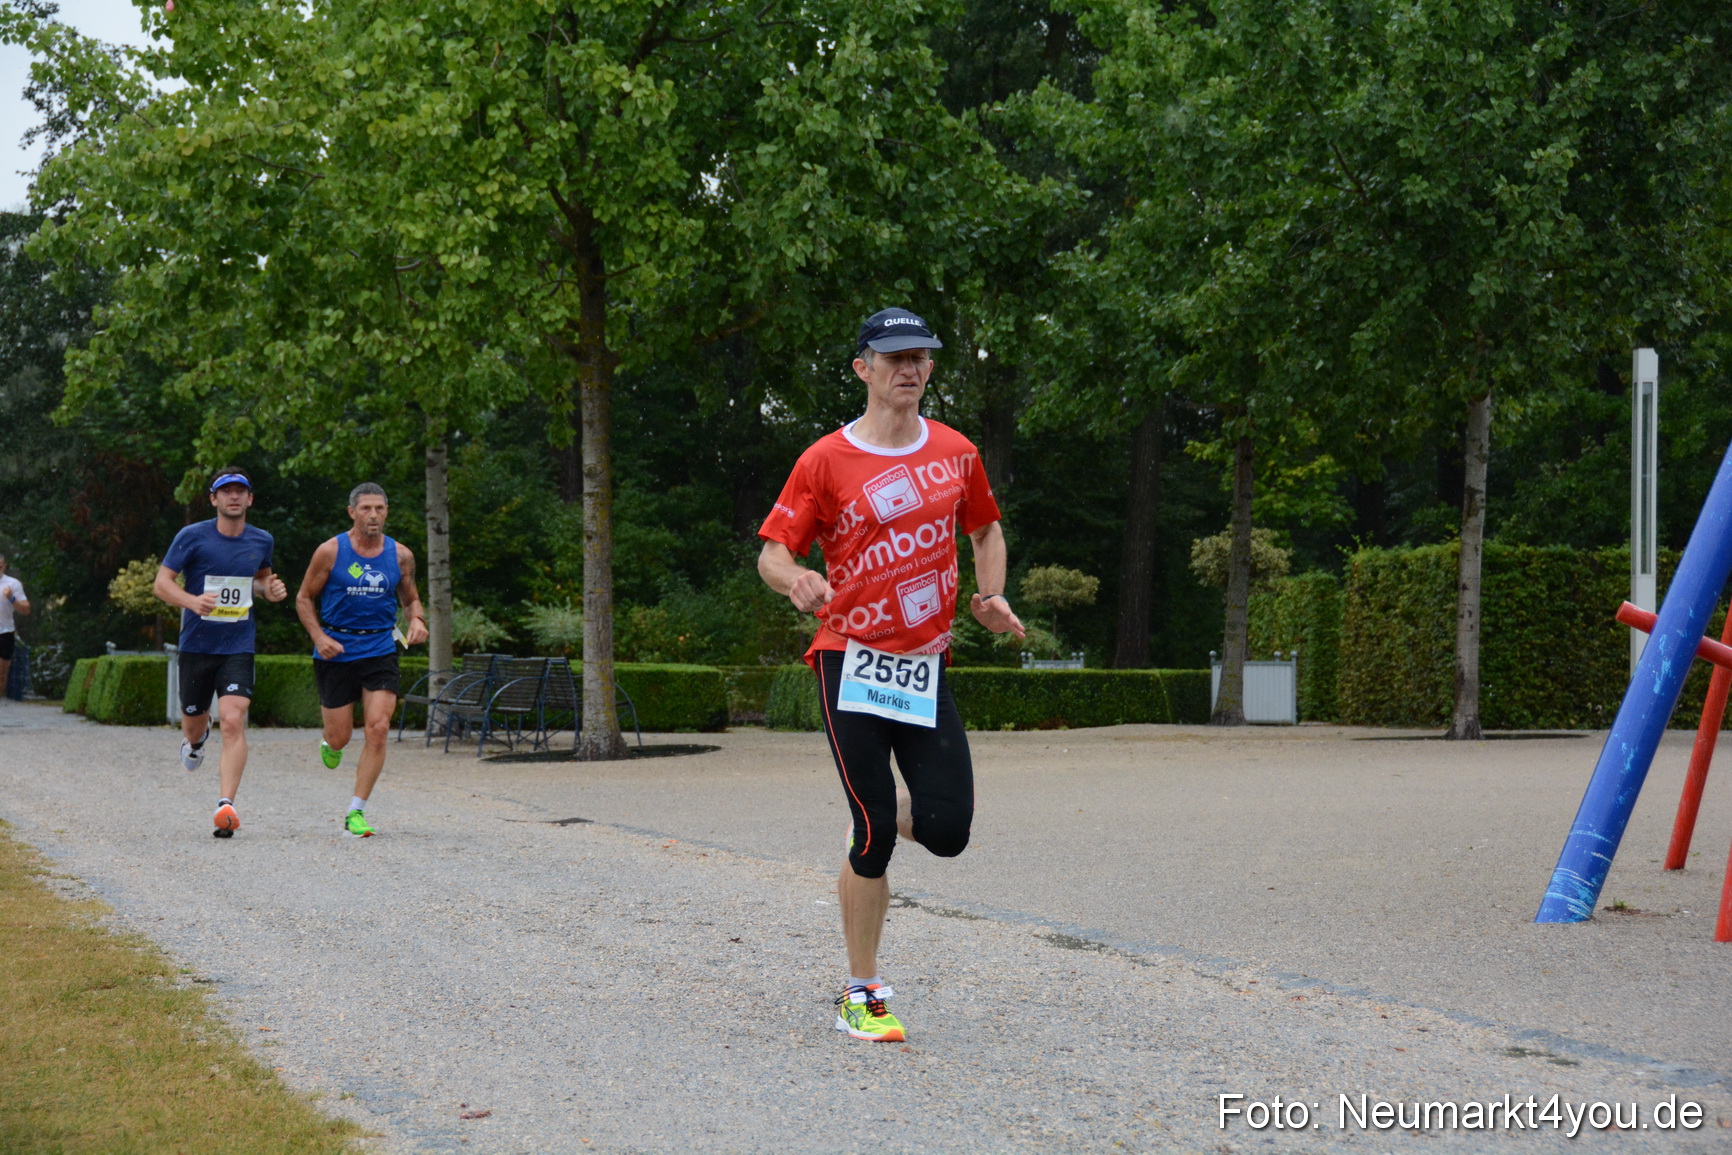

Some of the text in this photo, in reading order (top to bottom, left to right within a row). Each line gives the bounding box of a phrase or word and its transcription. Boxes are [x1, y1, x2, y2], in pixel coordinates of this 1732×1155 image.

[867, 468, 906, 493] raumbox
[928, 483, 968, 503] schenke
[871, 562, 913, 584] wohnen
[900, 575, 937, 595] raumbox
[220, 588, 241, 605] 99
[853, 649, 930, 693] 2559
[867, 689, 911, 711] Markus
